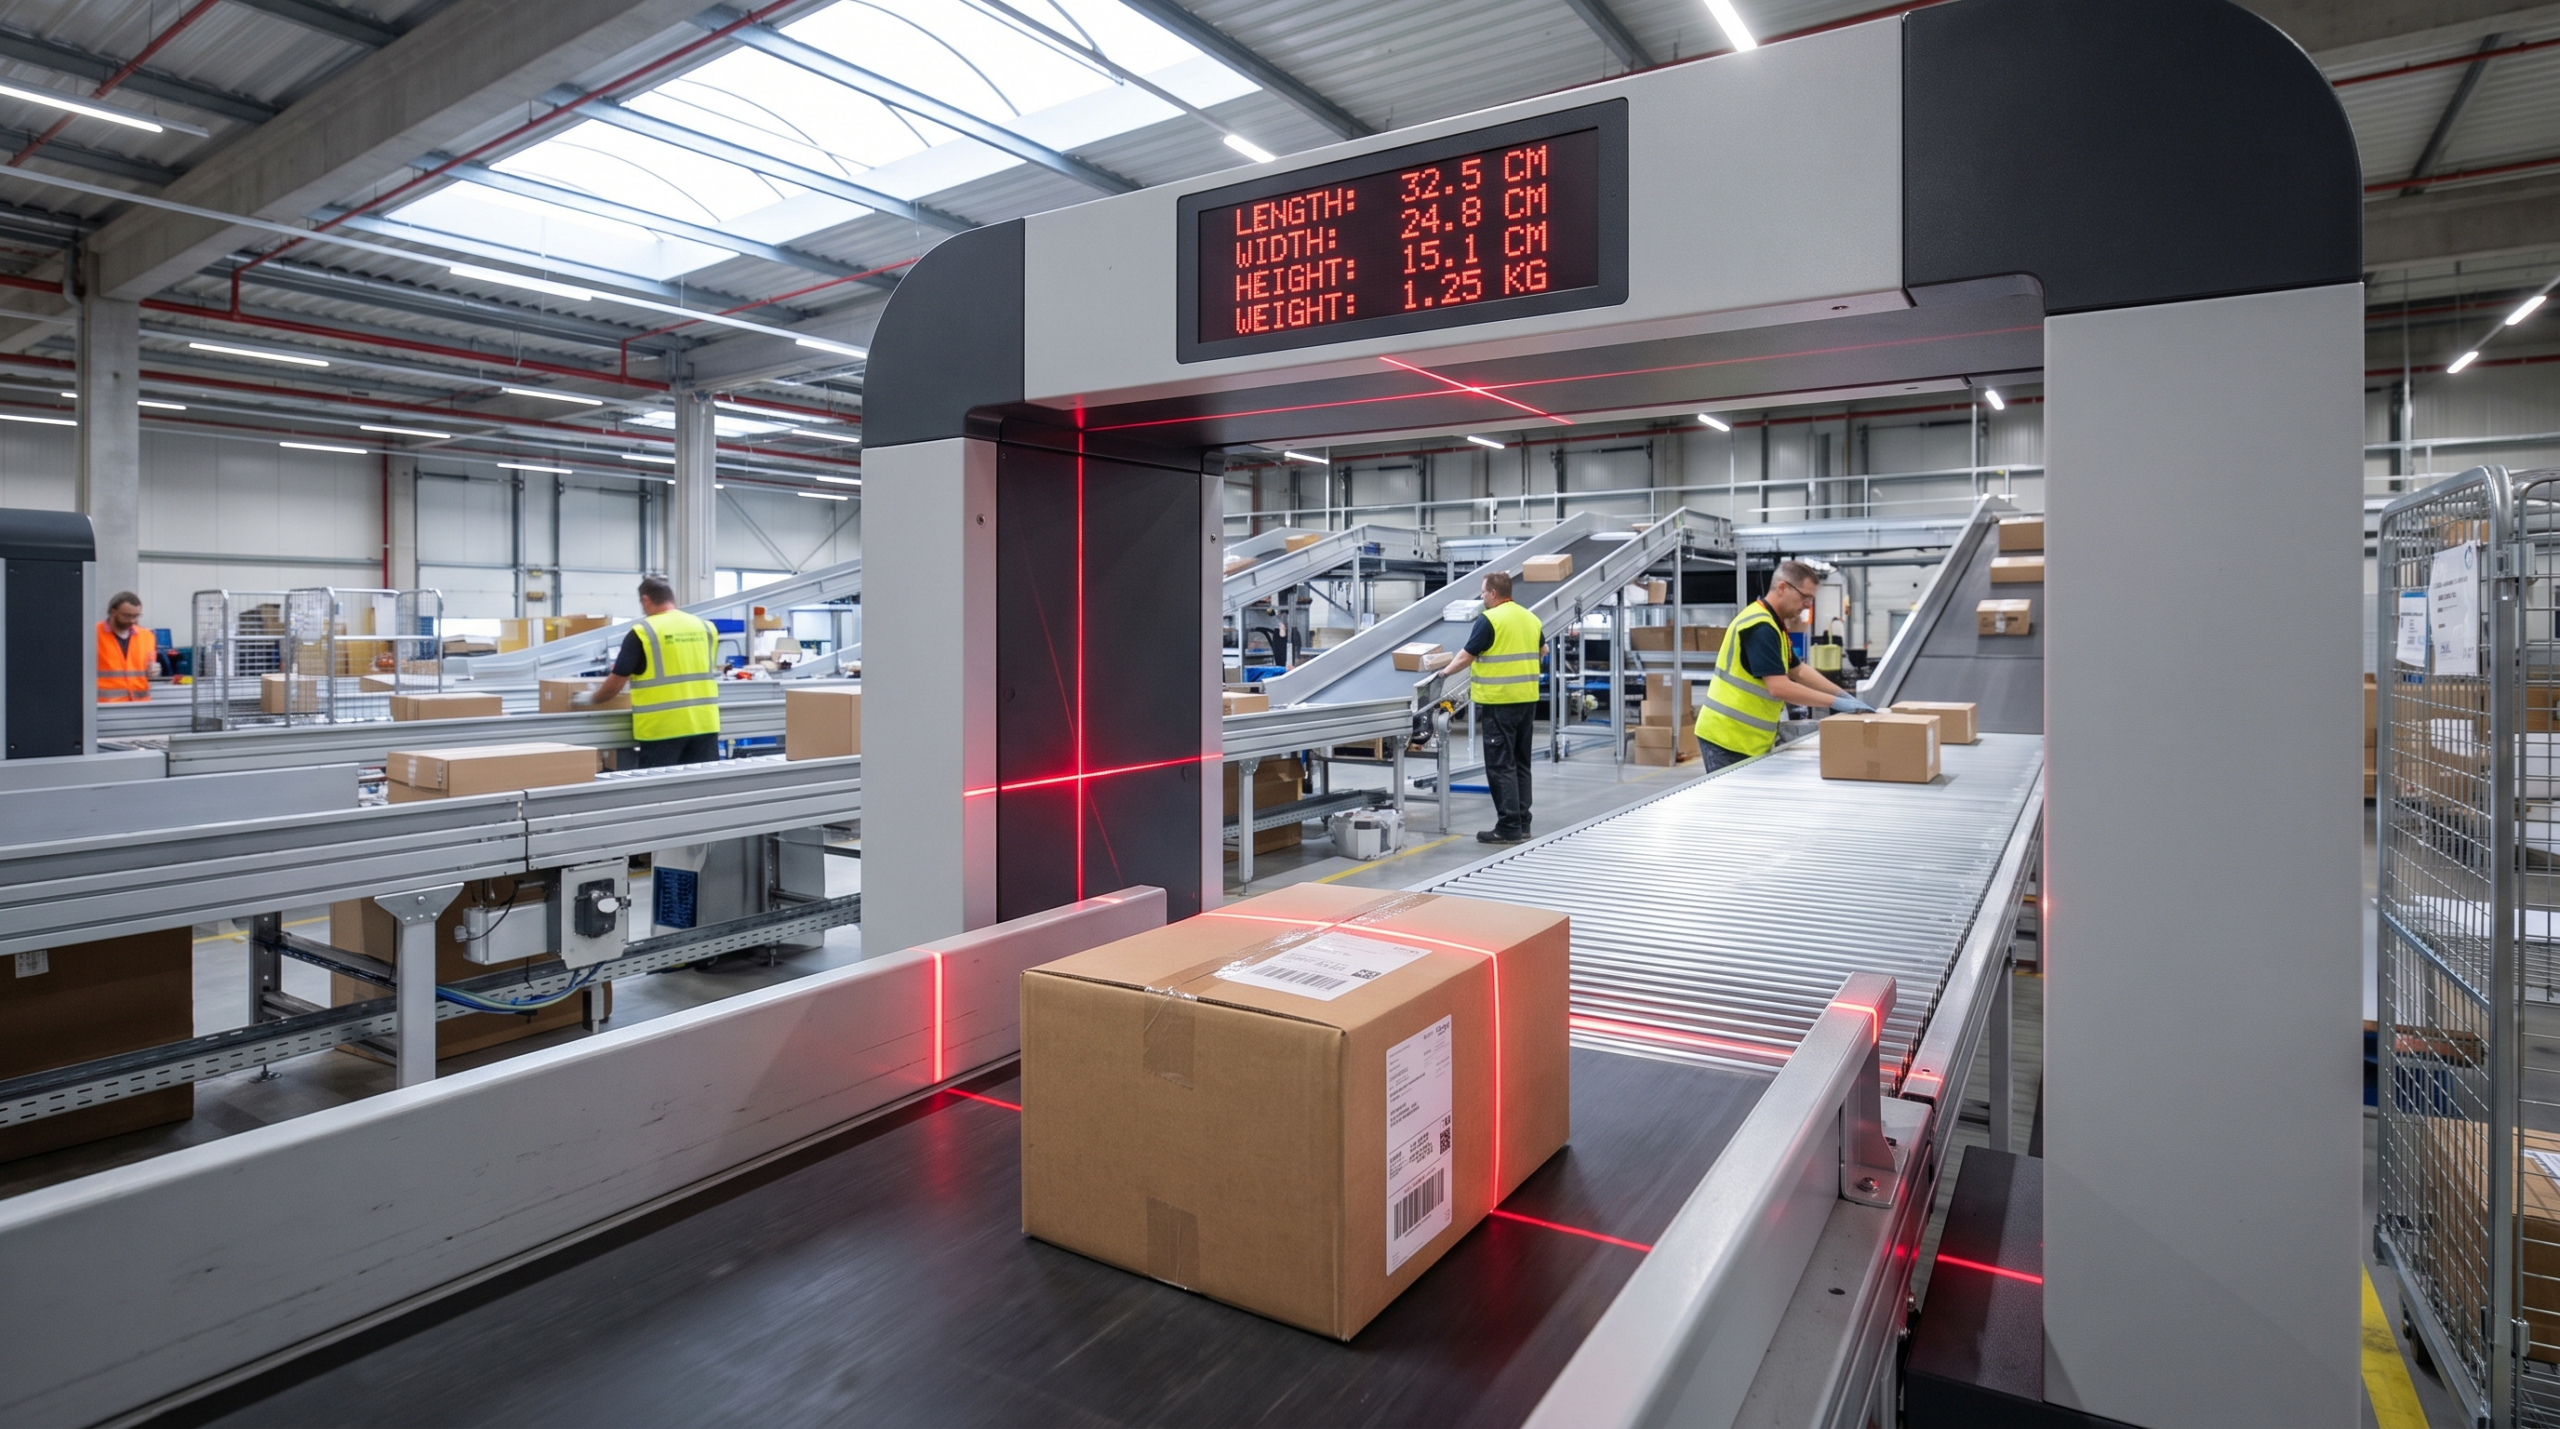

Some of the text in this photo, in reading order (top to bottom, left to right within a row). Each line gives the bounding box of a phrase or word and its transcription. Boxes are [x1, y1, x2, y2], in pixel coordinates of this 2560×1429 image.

[1236, 145, 1547, 236] LENGTH: 32.5 CM
[1236, 183, 1547, 269] WIDTH: 24.8 CM
[1236, 220, 1548, 301] HEIGHT: 15.1 CM
[1236, 258, 1548, 334] WEIGHT: 1.25 KG
